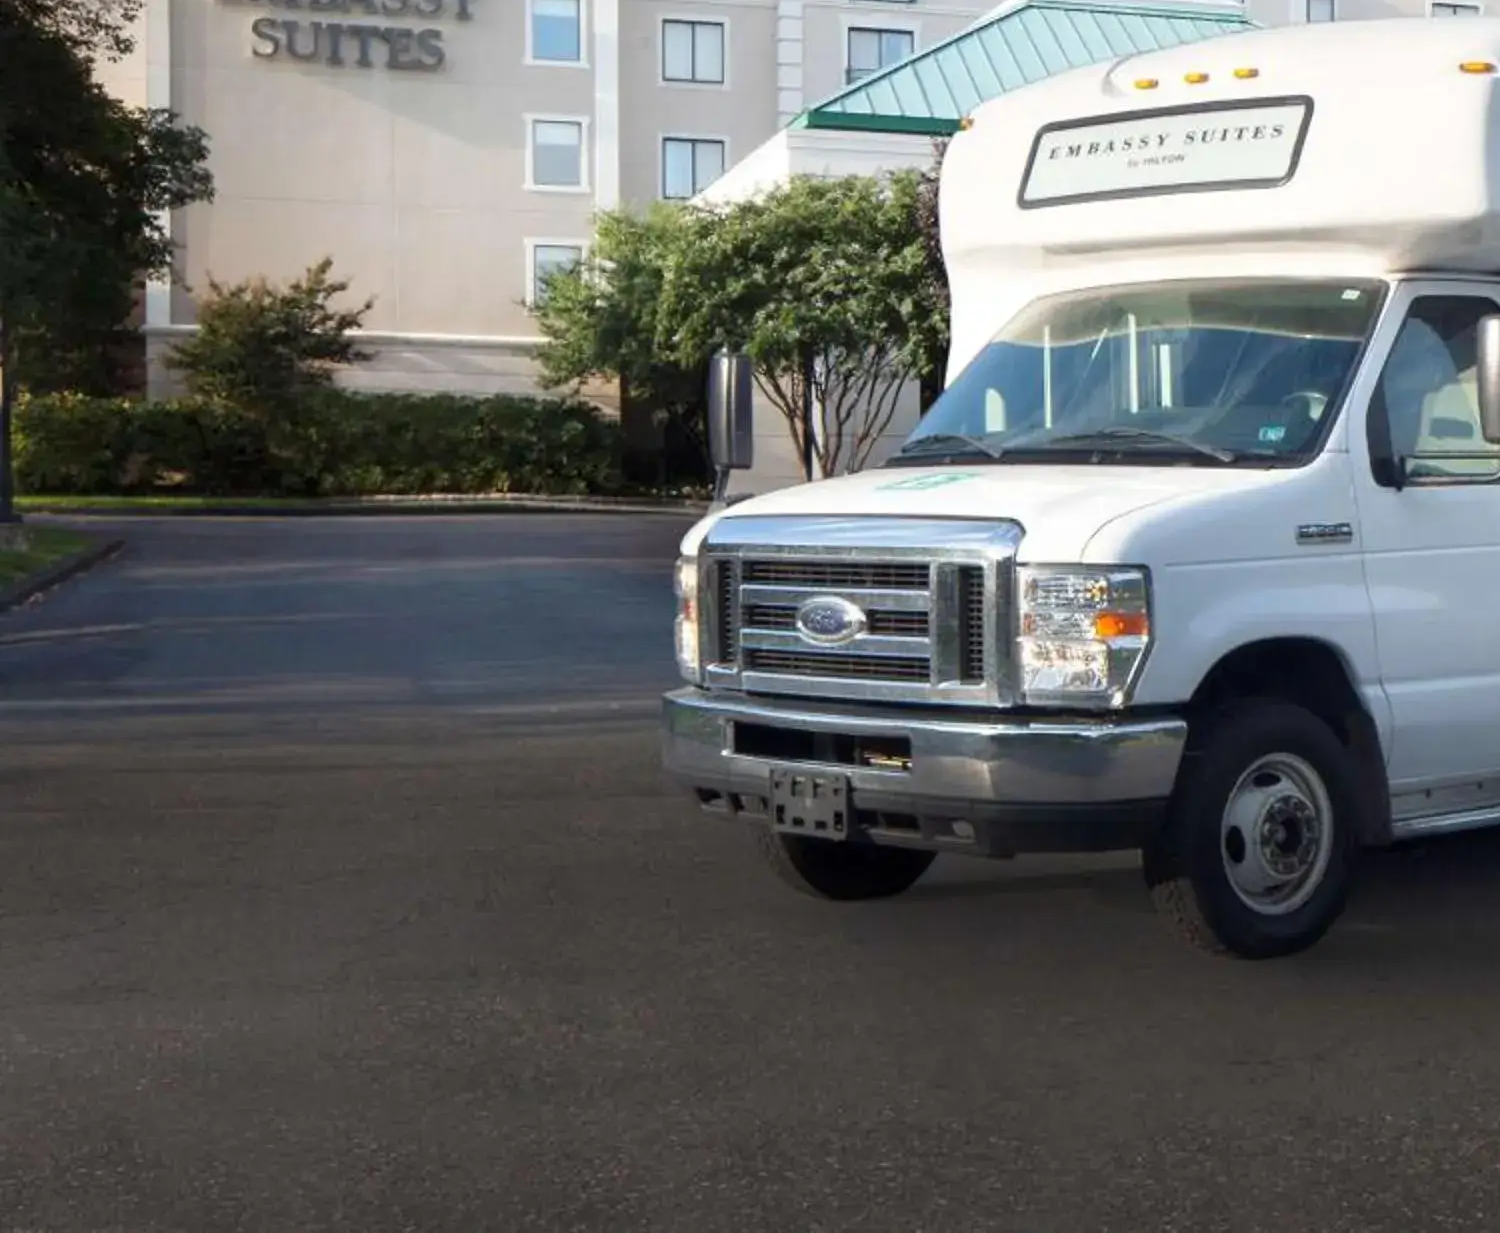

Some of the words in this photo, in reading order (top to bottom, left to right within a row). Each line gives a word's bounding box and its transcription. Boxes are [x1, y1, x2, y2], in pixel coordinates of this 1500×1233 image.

[252, 17, 446, 70] SUITES
[1049, 132, 1171, 160] EMBASSY
[1183, 124, 1285, 145] SUITES
